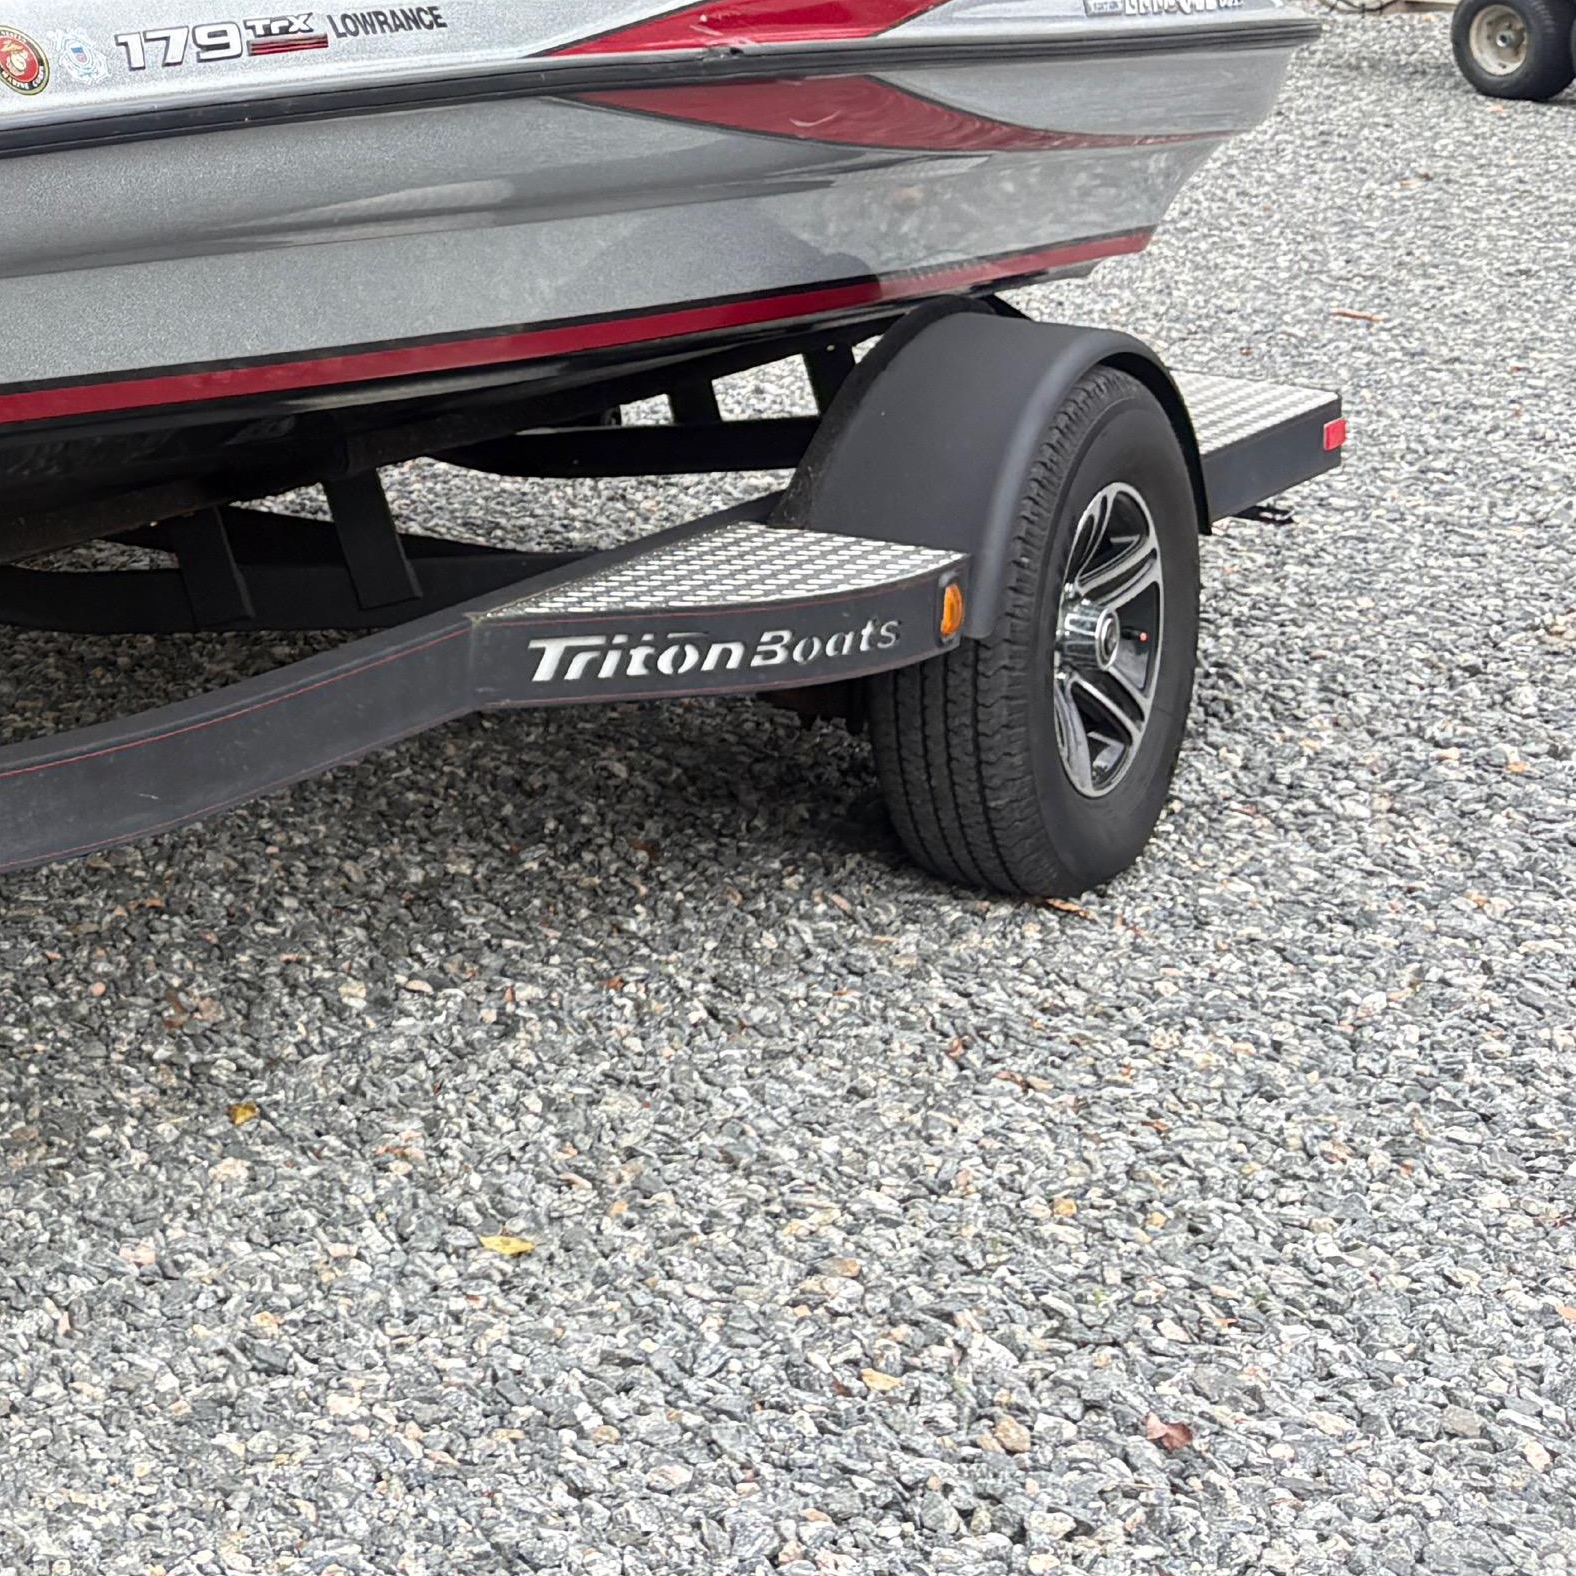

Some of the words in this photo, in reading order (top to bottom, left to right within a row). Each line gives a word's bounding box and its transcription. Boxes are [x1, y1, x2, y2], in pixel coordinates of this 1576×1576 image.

[114, 21, 244, 72] 179
[326, 4, 448, 39] LOWRANCE
[527, 631, 746, 682] Triton
[750, 618, 901, 668] Boats
